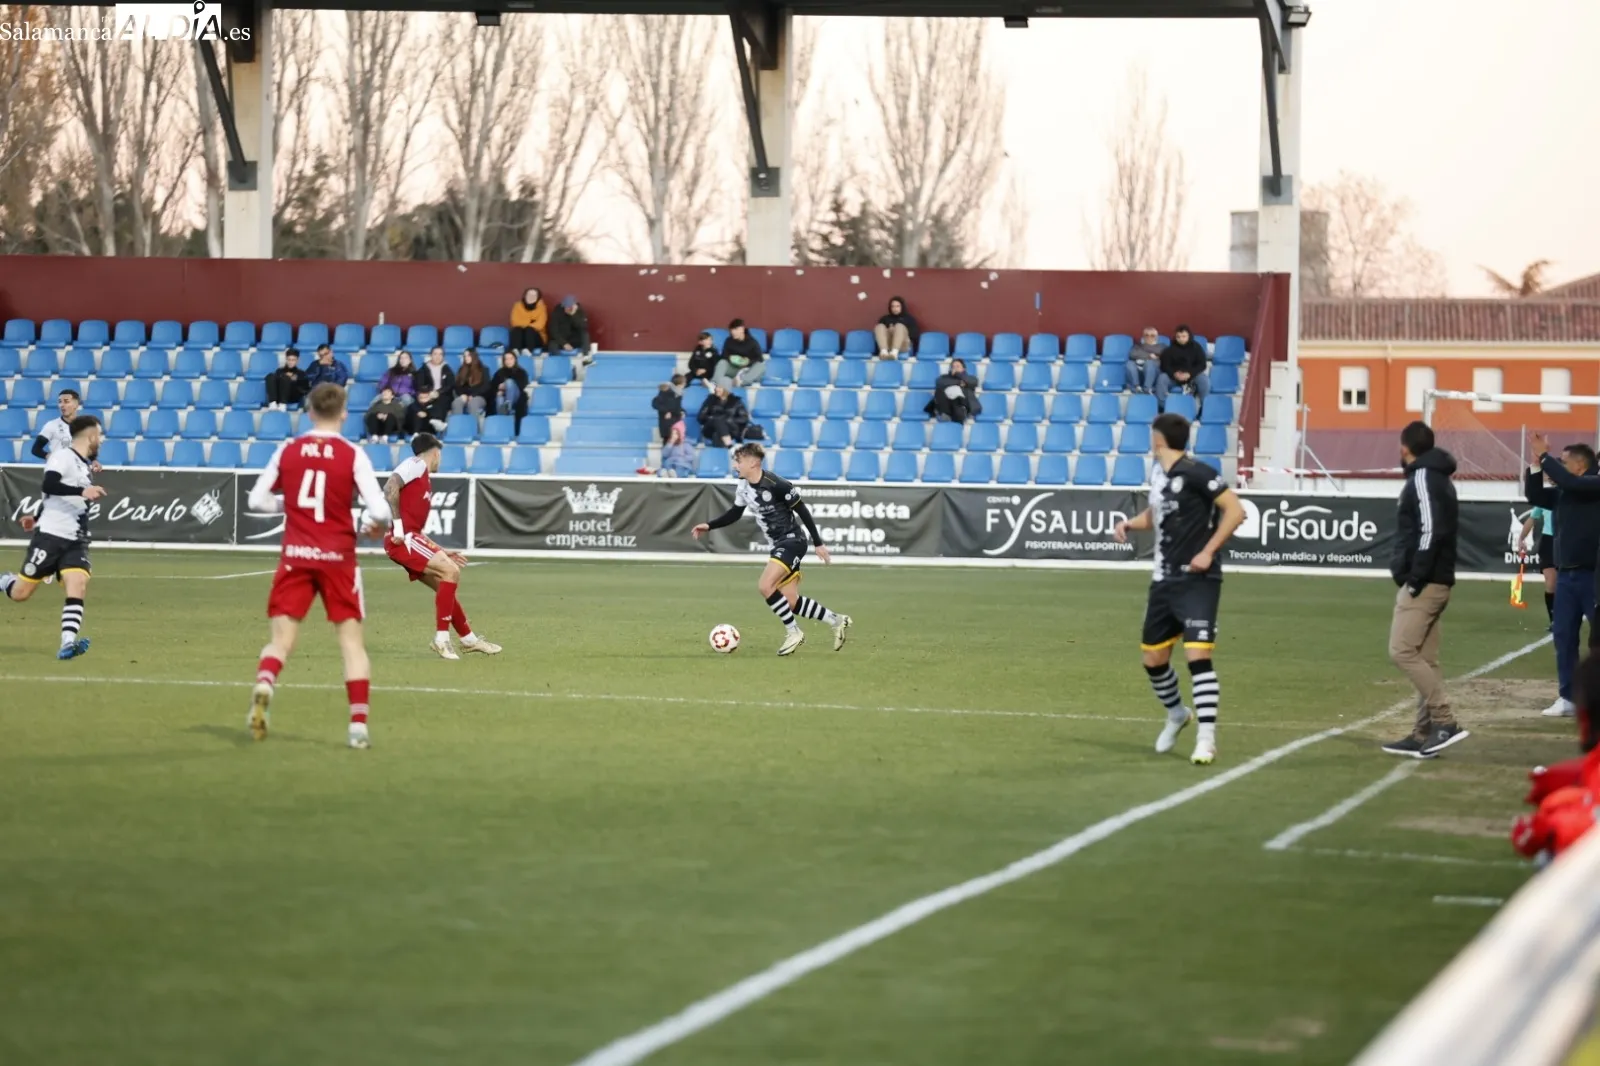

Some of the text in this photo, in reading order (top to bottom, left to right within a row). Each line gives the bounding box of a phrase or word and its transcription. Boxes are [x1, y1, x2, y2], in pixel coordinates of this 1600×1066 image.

[298, 469, 326, 523] 4
[108, 496, 187, 521] Carlo
[1261, 500, 1378, 546] fisaude
[30, 547, 47, 566] 19
[1084, 541, 1133, 551] DEPORTIVA
[1229, 550, 1373, 563] Tecnología médica y deportiva
